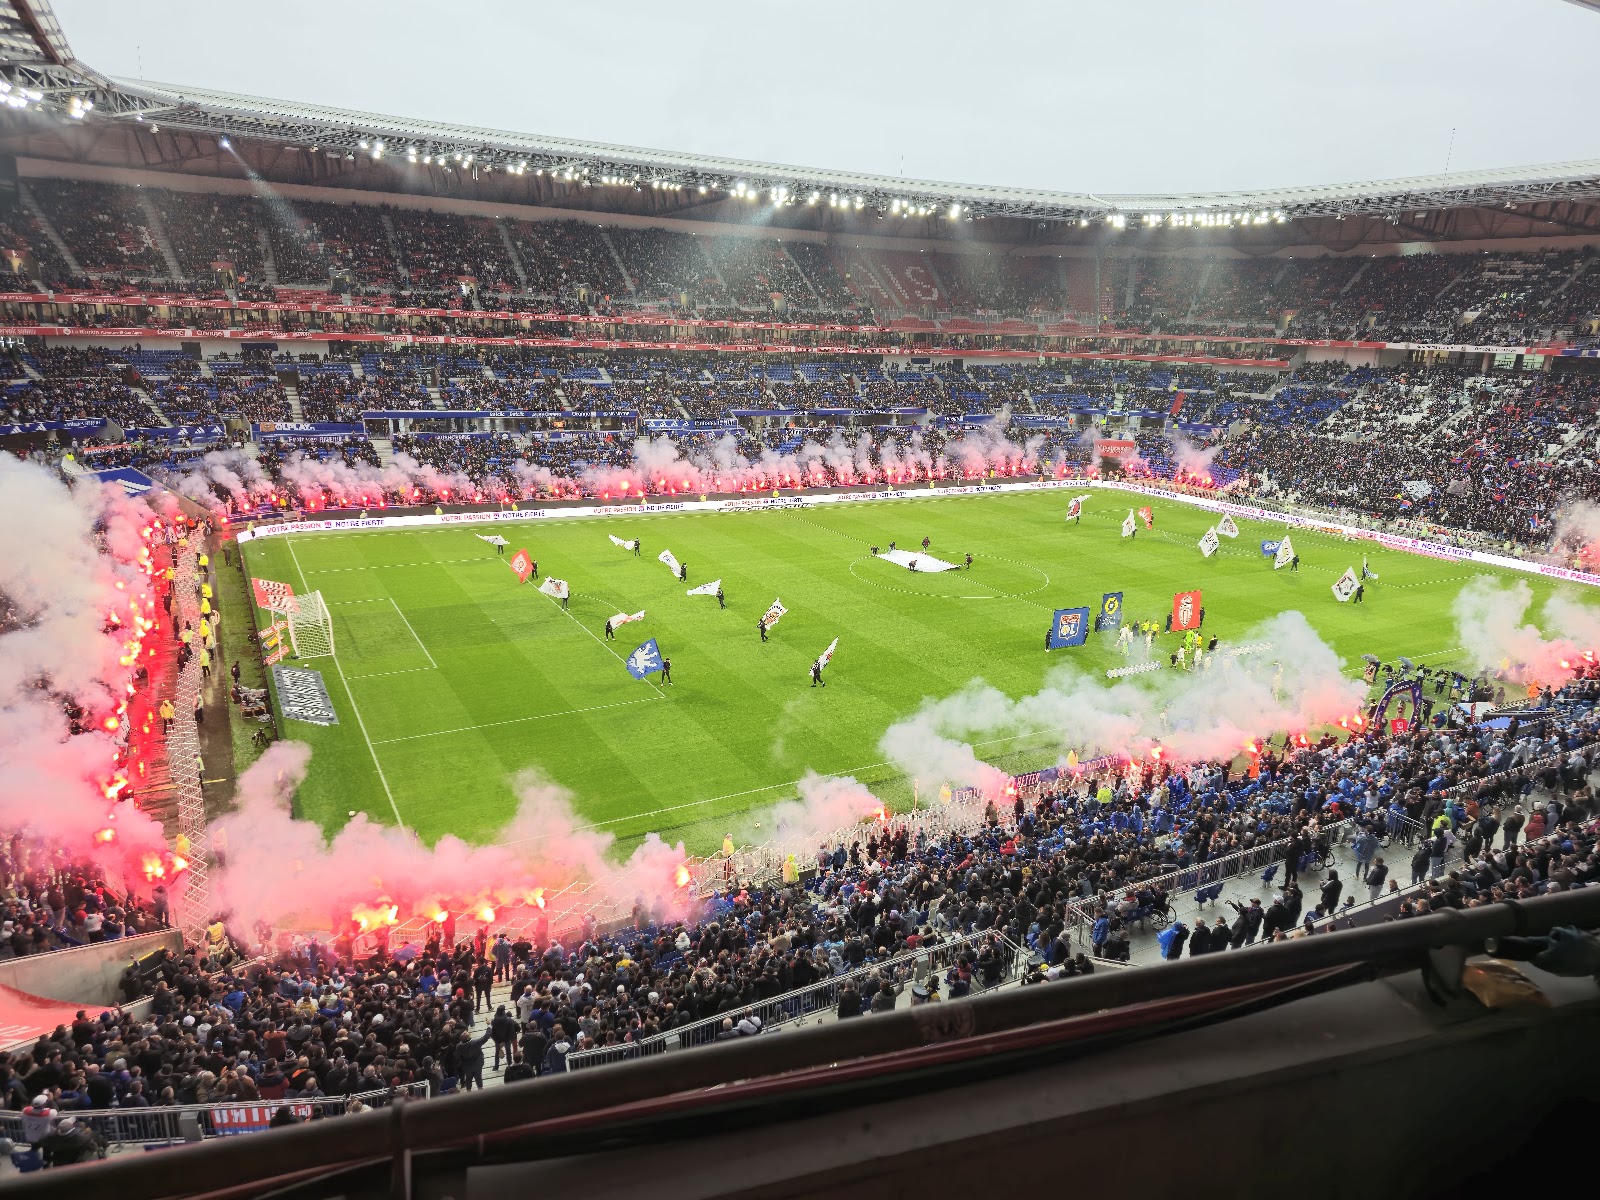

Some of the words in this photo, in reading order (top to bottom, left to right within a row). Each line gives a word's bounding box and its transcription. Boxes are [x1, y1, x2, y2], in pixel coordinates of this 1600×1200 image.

[266, 525, 289, 534] VOTRE
[291, 523, 322, 531] PASSION
[335, 520, 360, 528] NOTRE
[1356, 529, 1379, 539] VOTRE
[1379, 534, 1409, 545] PASSION
[1421, 542, 1447, 553] NOTRE
[1540, 565, 1568, 577] VOTRE
[1017, 772, 1041, 788] BETTER
